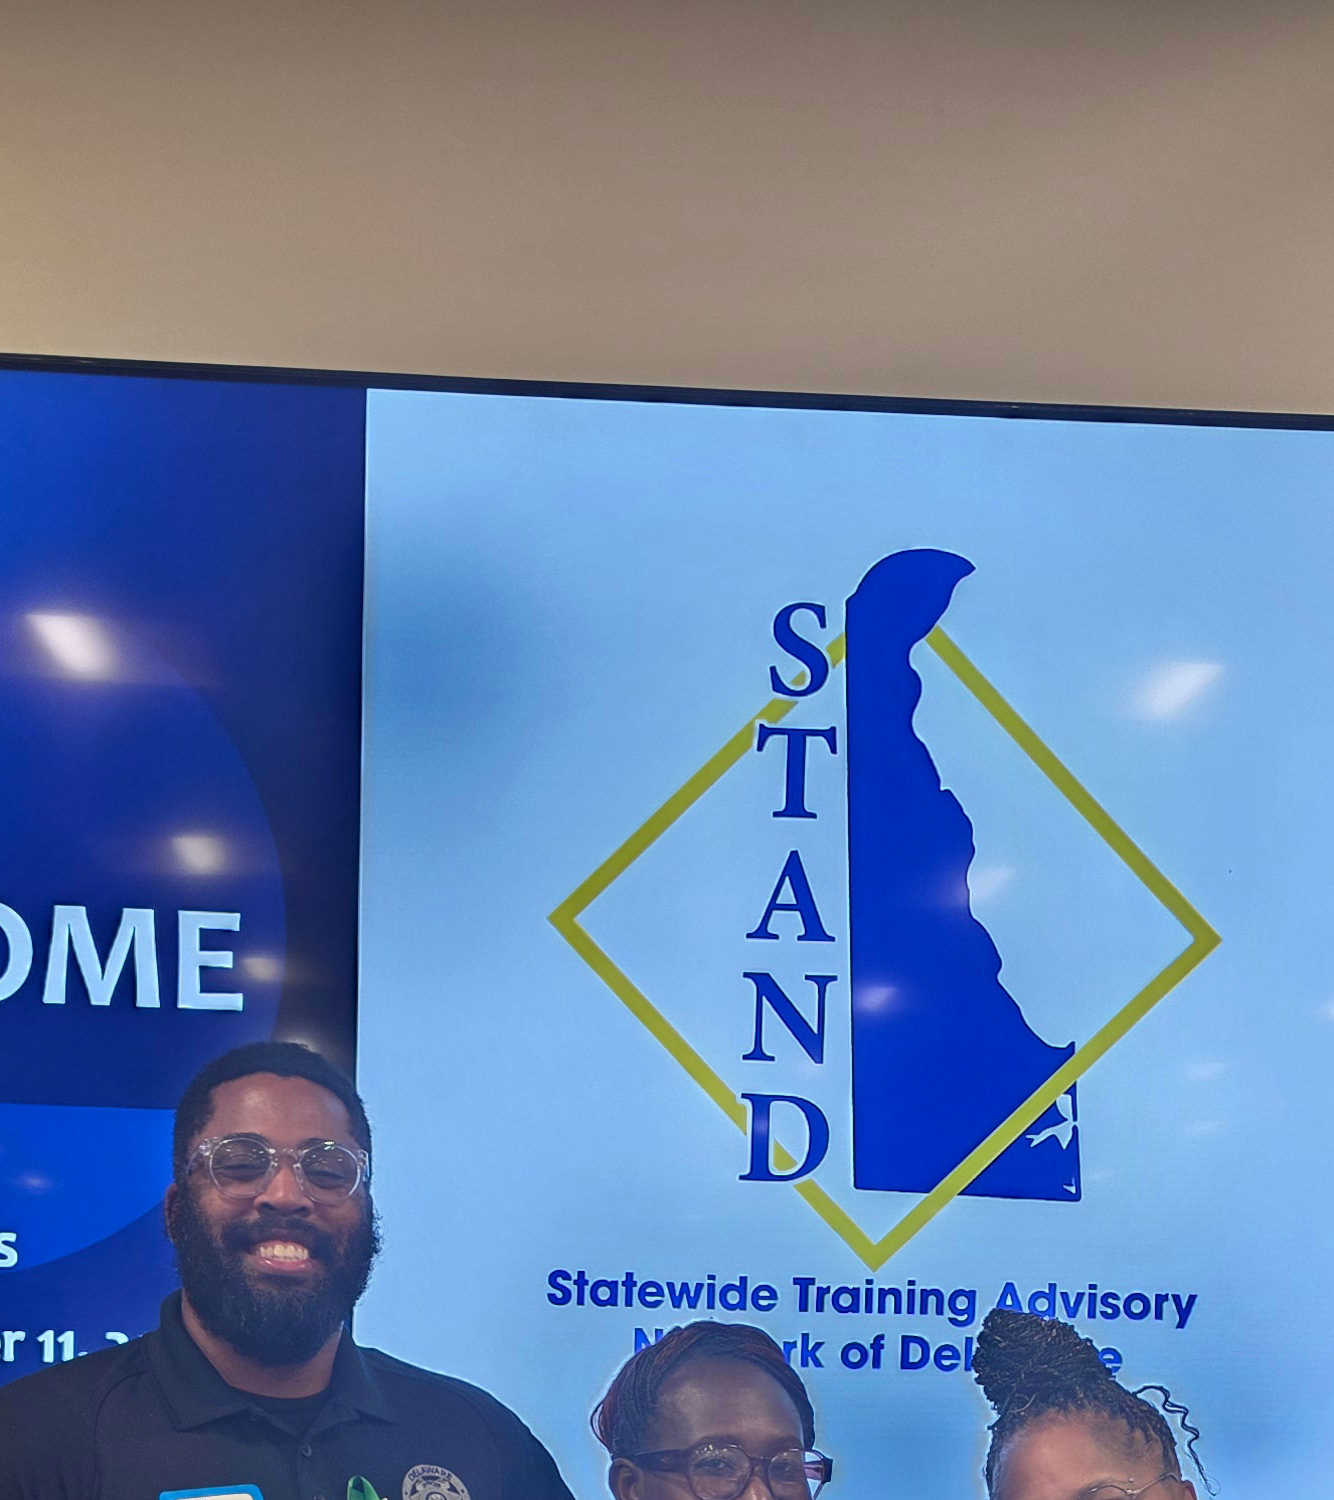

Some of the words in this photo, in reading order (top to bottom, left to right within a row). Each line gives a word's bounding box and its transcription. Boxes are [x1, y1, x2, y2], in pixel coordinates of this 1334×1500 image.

[738, 602, 838, 1183] STAND
[546, 1269, 779, 1314] Statewide
[793, 1275, 977, 1328] Training
[995, 1280, 1199, 1330] Advisory
[840, 1331, 884, 1371] of
[899, 1334, 1123, 1375] Dele
[408, 1467, 452, 1481] DELAWARE
